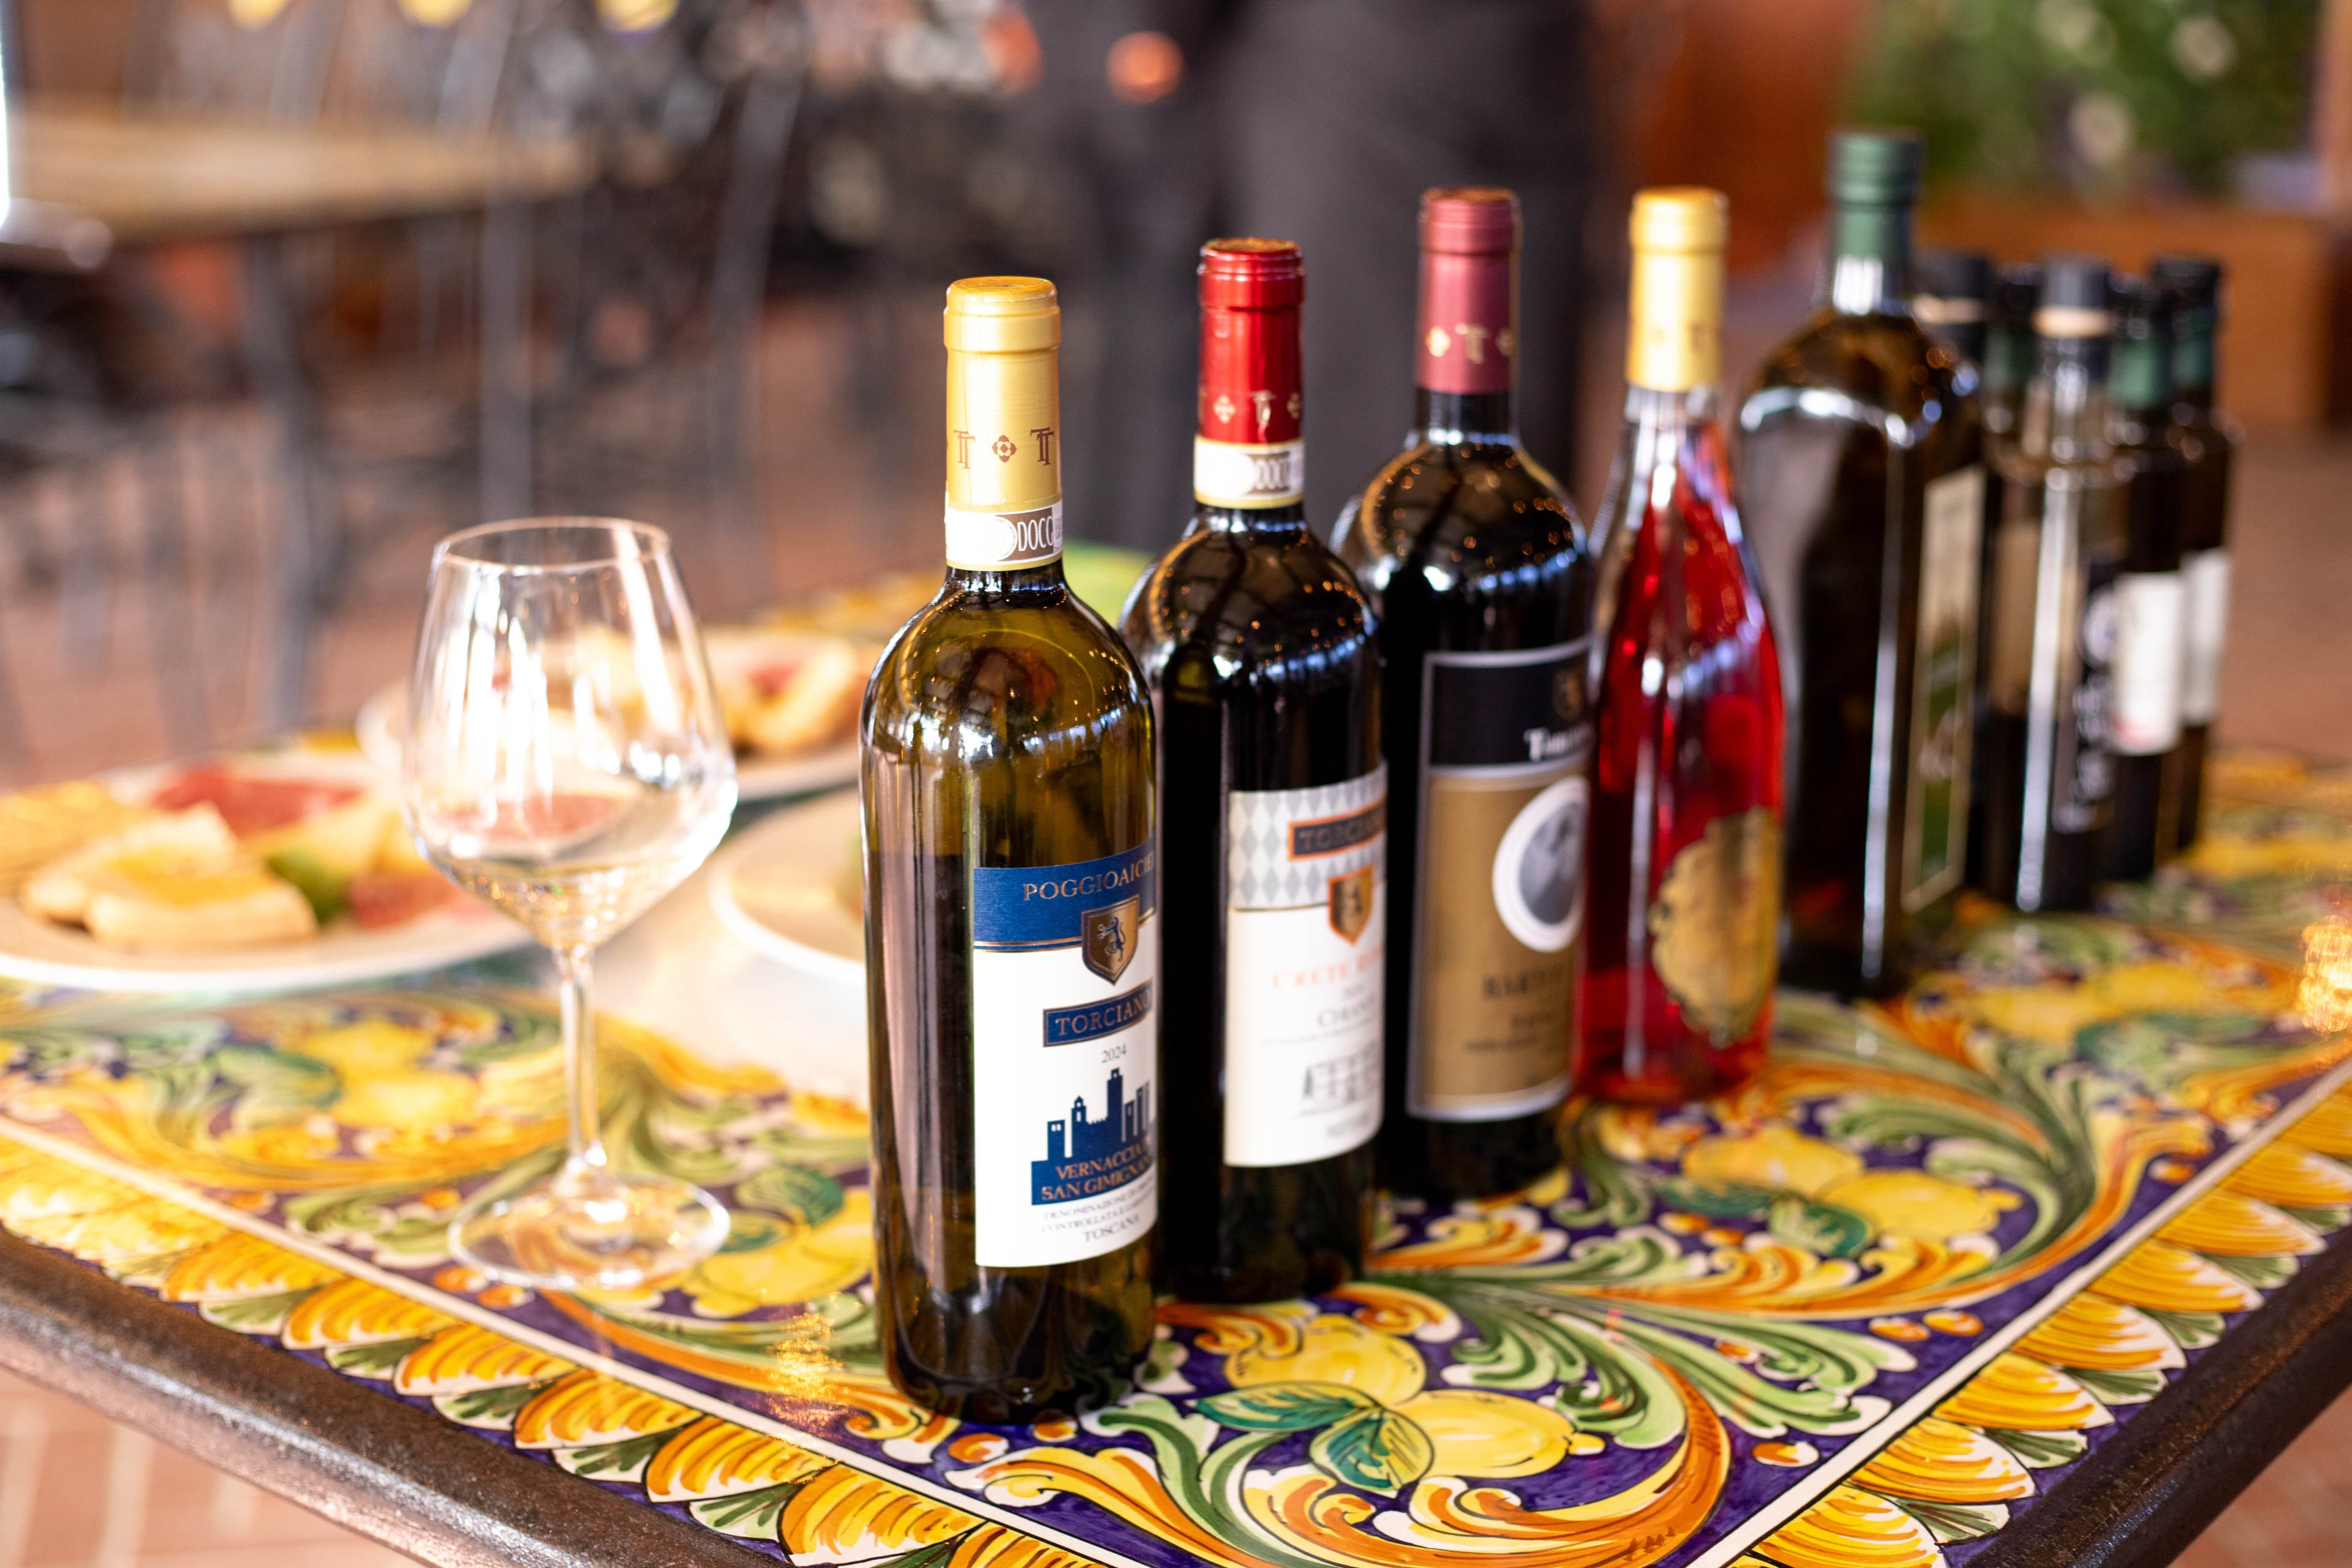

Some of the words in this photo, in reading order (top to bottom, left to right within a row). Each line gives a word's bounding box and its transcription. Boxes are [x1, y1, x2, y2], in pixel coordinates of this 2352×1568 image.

[1102, 1043, 1127, 1063] 2024
[1041, 1182, 1081, 1201] SAN
[1084, 1213, 1140, 1243] TOSCANA
